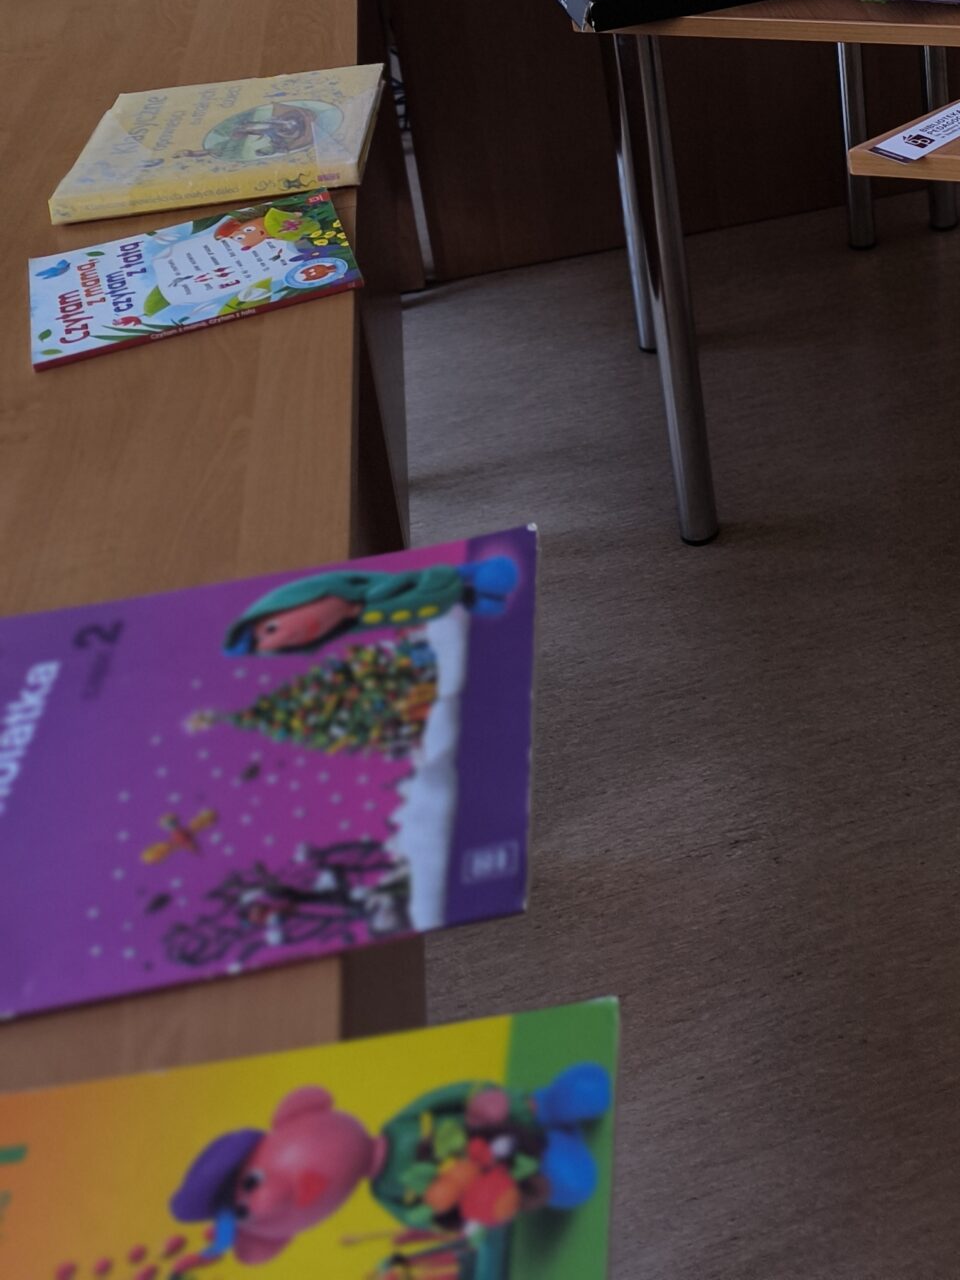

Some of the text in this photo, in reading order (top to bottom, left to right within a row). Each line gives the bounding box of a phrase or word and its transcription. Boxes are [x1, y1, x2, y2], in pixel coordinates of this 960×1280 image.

[111, 95, 168, 155] Klasyczne
[77, 257, 106, 306] z mamą,
[115, 240, 148, 277] z tatą
[104, 271, 137, 313] czytam
[57, 289, 92, 345] Czytam
